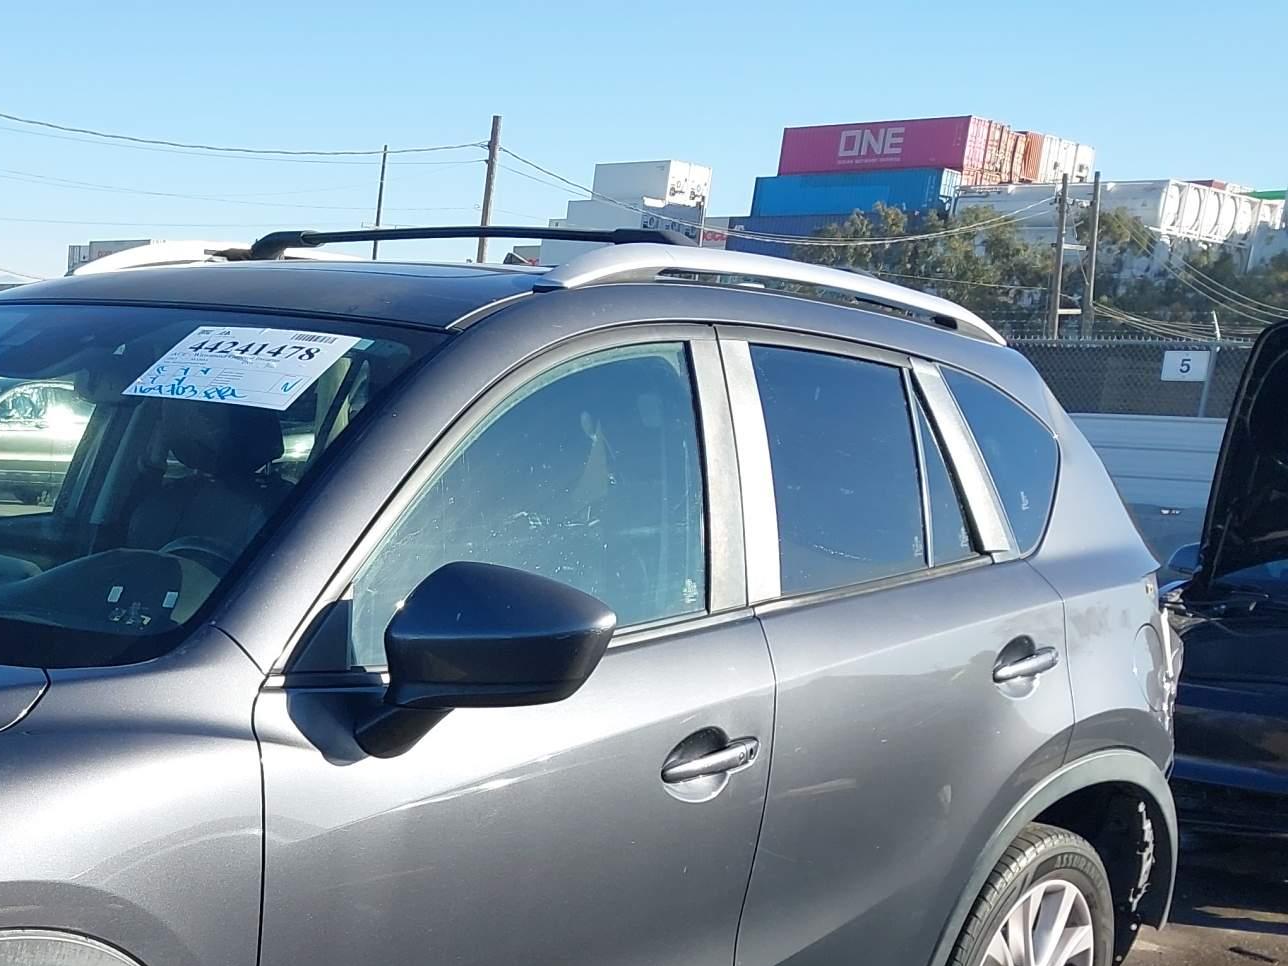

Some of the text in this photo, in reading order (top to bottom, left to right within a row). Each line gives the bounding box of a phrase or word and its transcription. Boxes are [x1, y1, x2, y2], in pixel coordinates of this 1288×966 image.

[838, 127, 905, 157] ONE
[189, 339, 321, 361] 44241478
[1179, 358, 1192, 374] 5
